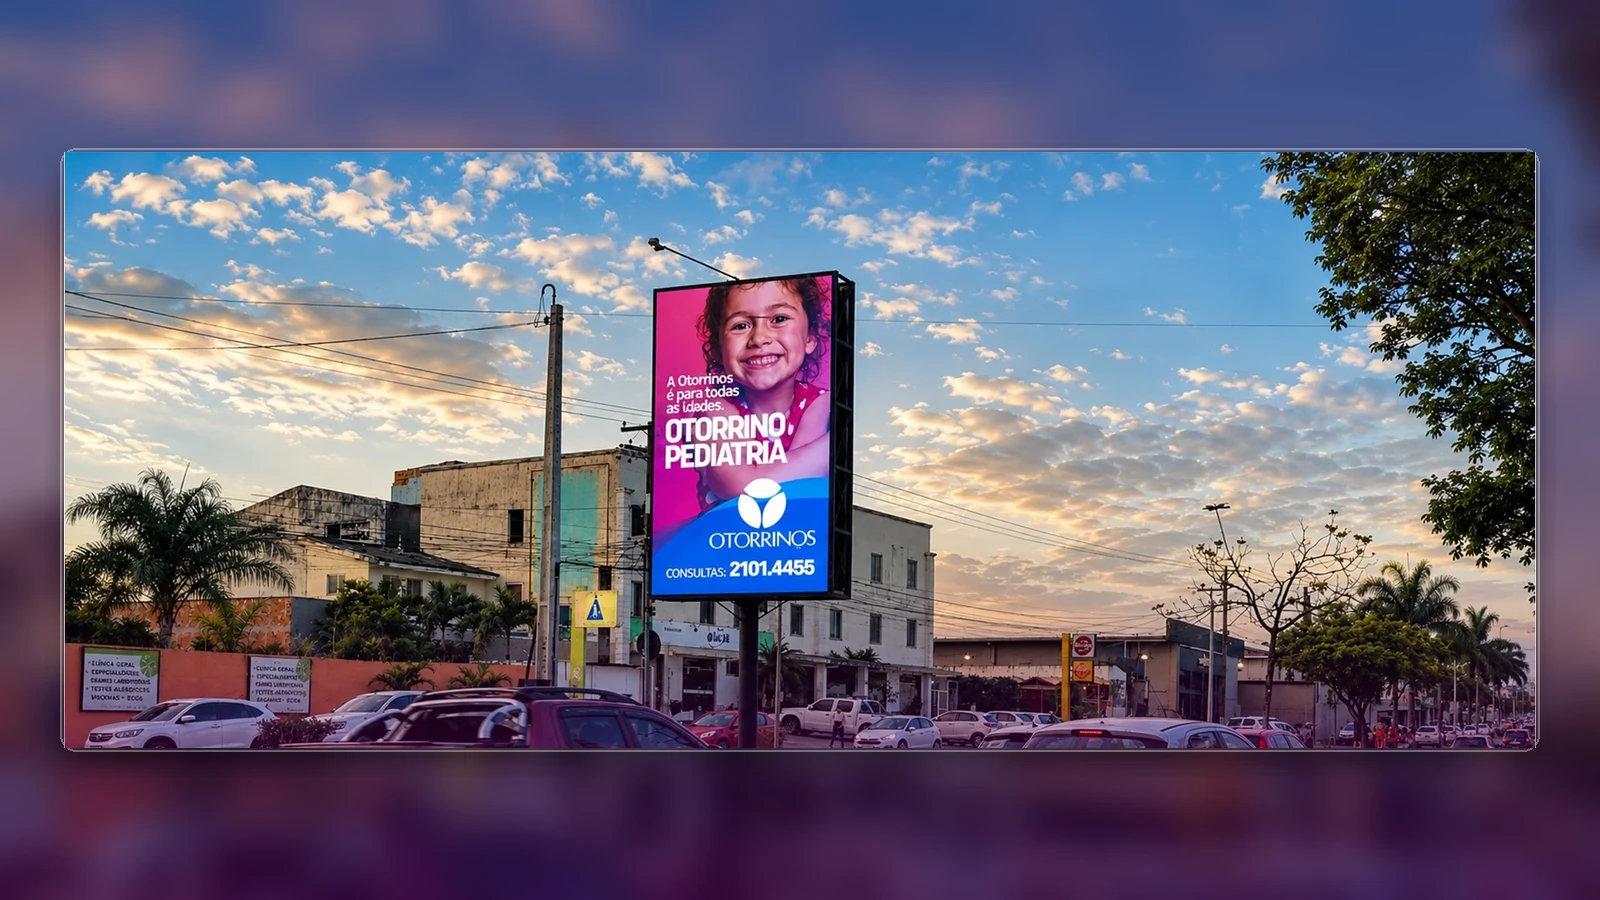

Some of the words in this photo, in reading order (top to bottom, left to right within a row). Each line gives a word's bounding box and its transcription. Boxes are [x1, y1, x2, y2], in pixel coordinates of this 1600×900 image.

[667, 376, 675, 387] A
[678, 374, 734, 387] Otorrinos
[666, 389, 674, 400] é
[676, 389, 703, 403] para
[705, 386, 740, 399] todas
[666, 404, 680, 414] as
[665, 412, 786, 443] OTORRINO
[665, 439, 788, 469] PEDIATRIA
[709, 529, 817, 549] OTORRINOS
[666, 567, 727, 579] CONSULTAS:
[729, 559, 815, 577] 2101.4455
